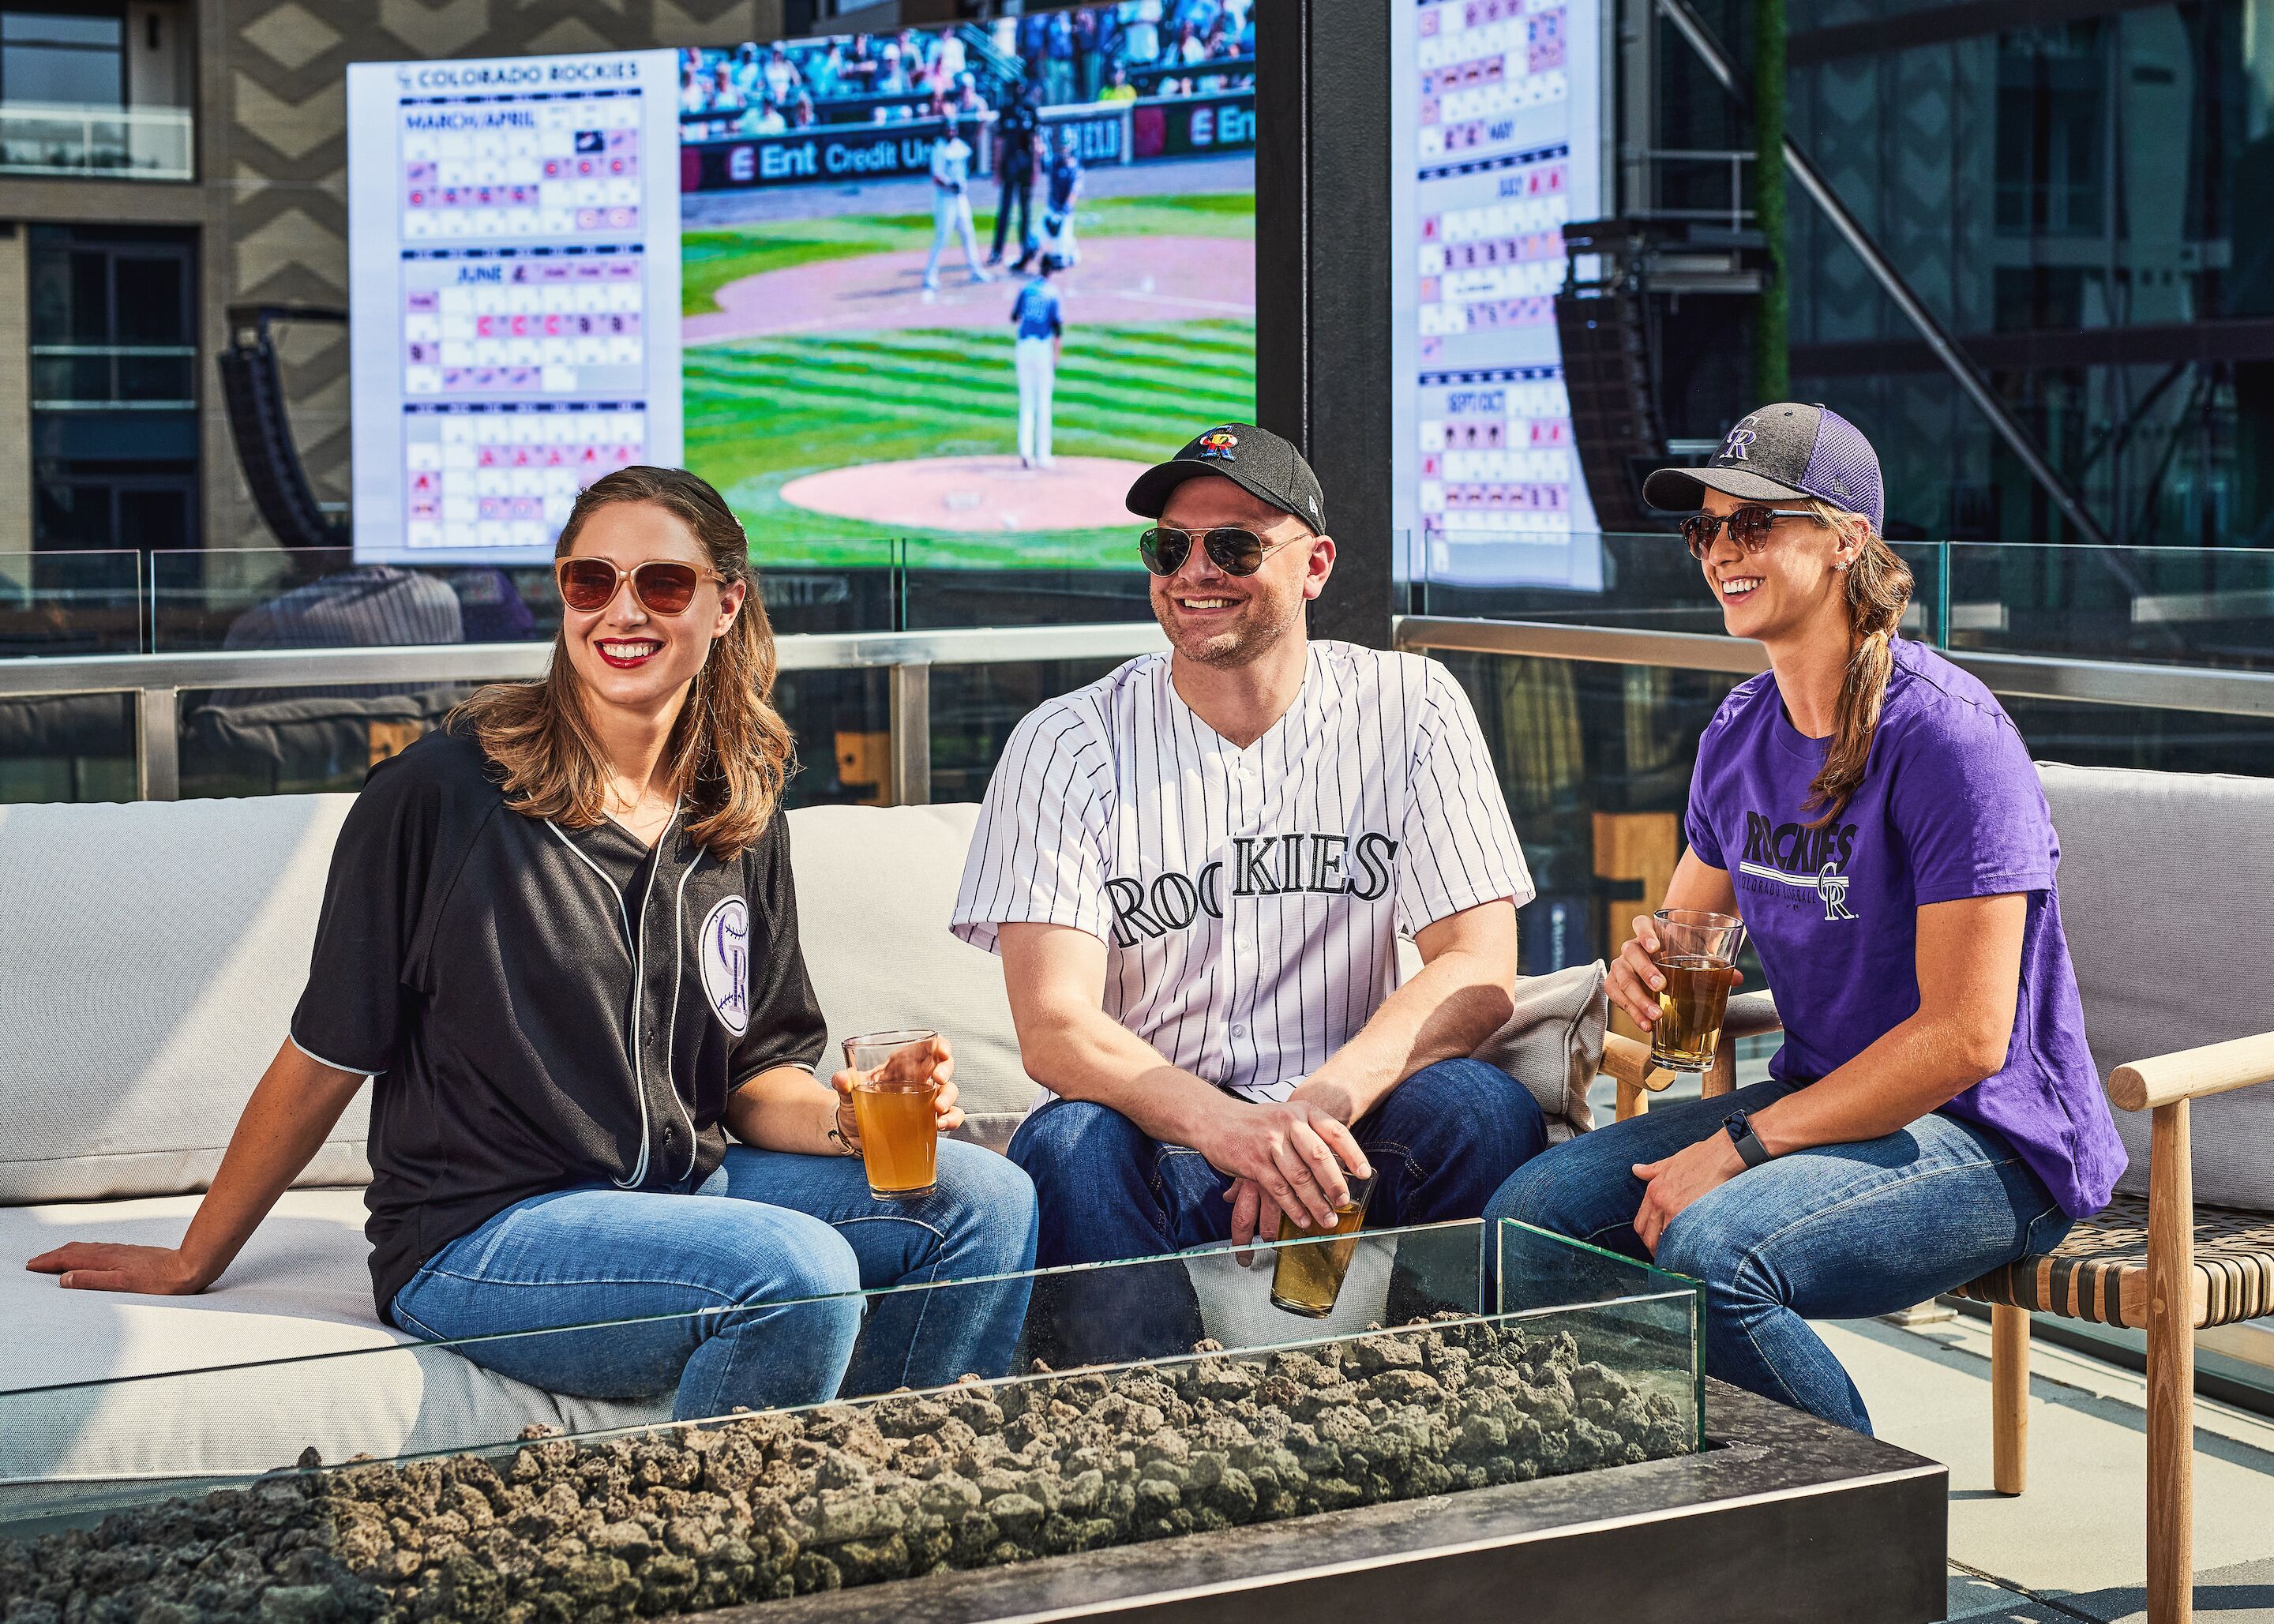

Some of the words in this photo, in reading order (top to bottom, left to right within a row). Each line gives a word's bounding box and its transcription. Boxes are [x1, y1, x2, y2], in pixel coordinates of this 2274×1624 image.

[418, 65, 542, 88] COLORADO
[550, 61, 638, 81] ROCKIES
[760, 141, 818, 178] Ent
[825, 140, 898, 173] Credit
[458, 264, 502, 283] JUNE
[1742, 811, 1858, 874] ROCKIES
[1738, 875, 1780, 898] COLORADO
